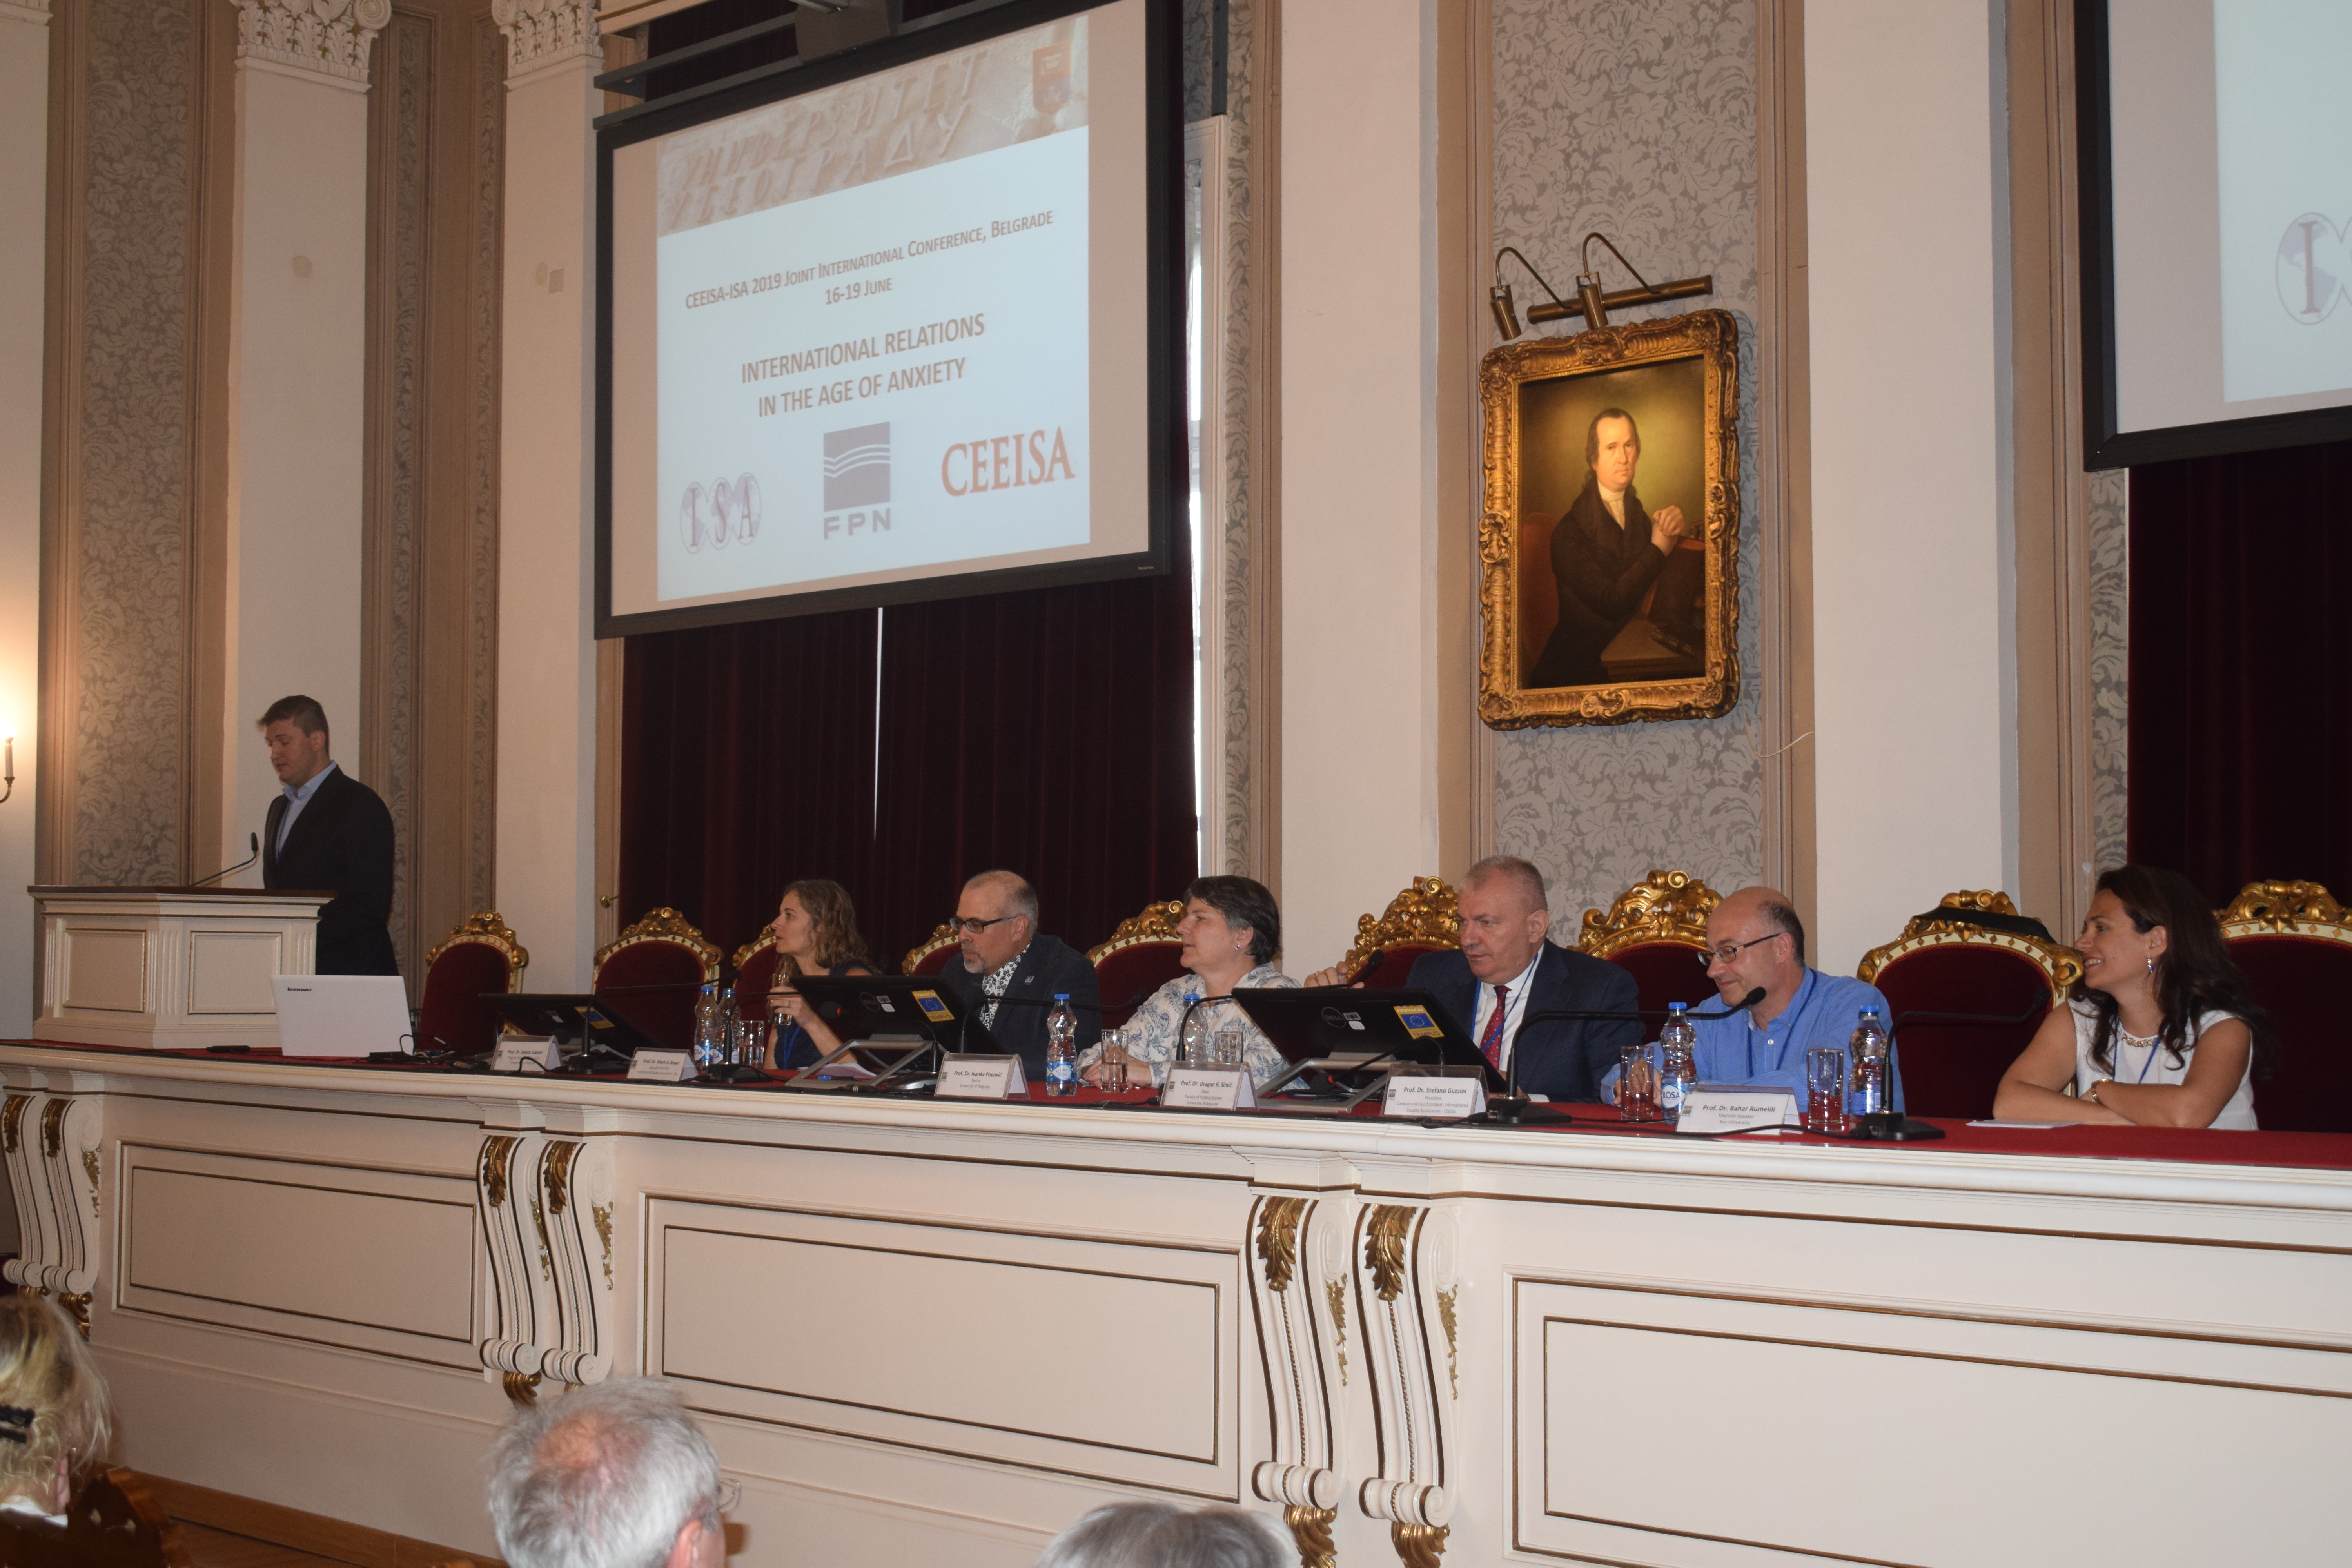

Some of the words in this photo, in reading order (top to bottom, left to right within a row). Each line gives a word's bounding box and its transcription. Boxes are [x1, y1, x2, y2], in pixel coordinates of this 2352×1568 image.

[685, 281, 749, 309] CEEISA-ISA
[752, 273, 782, 294] 2019
[818, 247, 904, 278] INTERNATIONAL
[991, 211, 1053, 238] BELGRADE
[825, 282, 861, 305] 16-19
[742, 337, 880, 383] INTERNATIONAL
[885, 313, 985, 355] RELATIONS
[759, 395, 776, 417] IN
[781, 388, 813, 412] THE
[818, 380, 853, 406] AGE
[858, 374, 882, 398] OF
[887, 357, 966, 393] ANXIETY
[942, 426, 1076, 497] CEEISA
[690, 477, 755, 547] ISA
[824, 508, 891, 540] FPN
